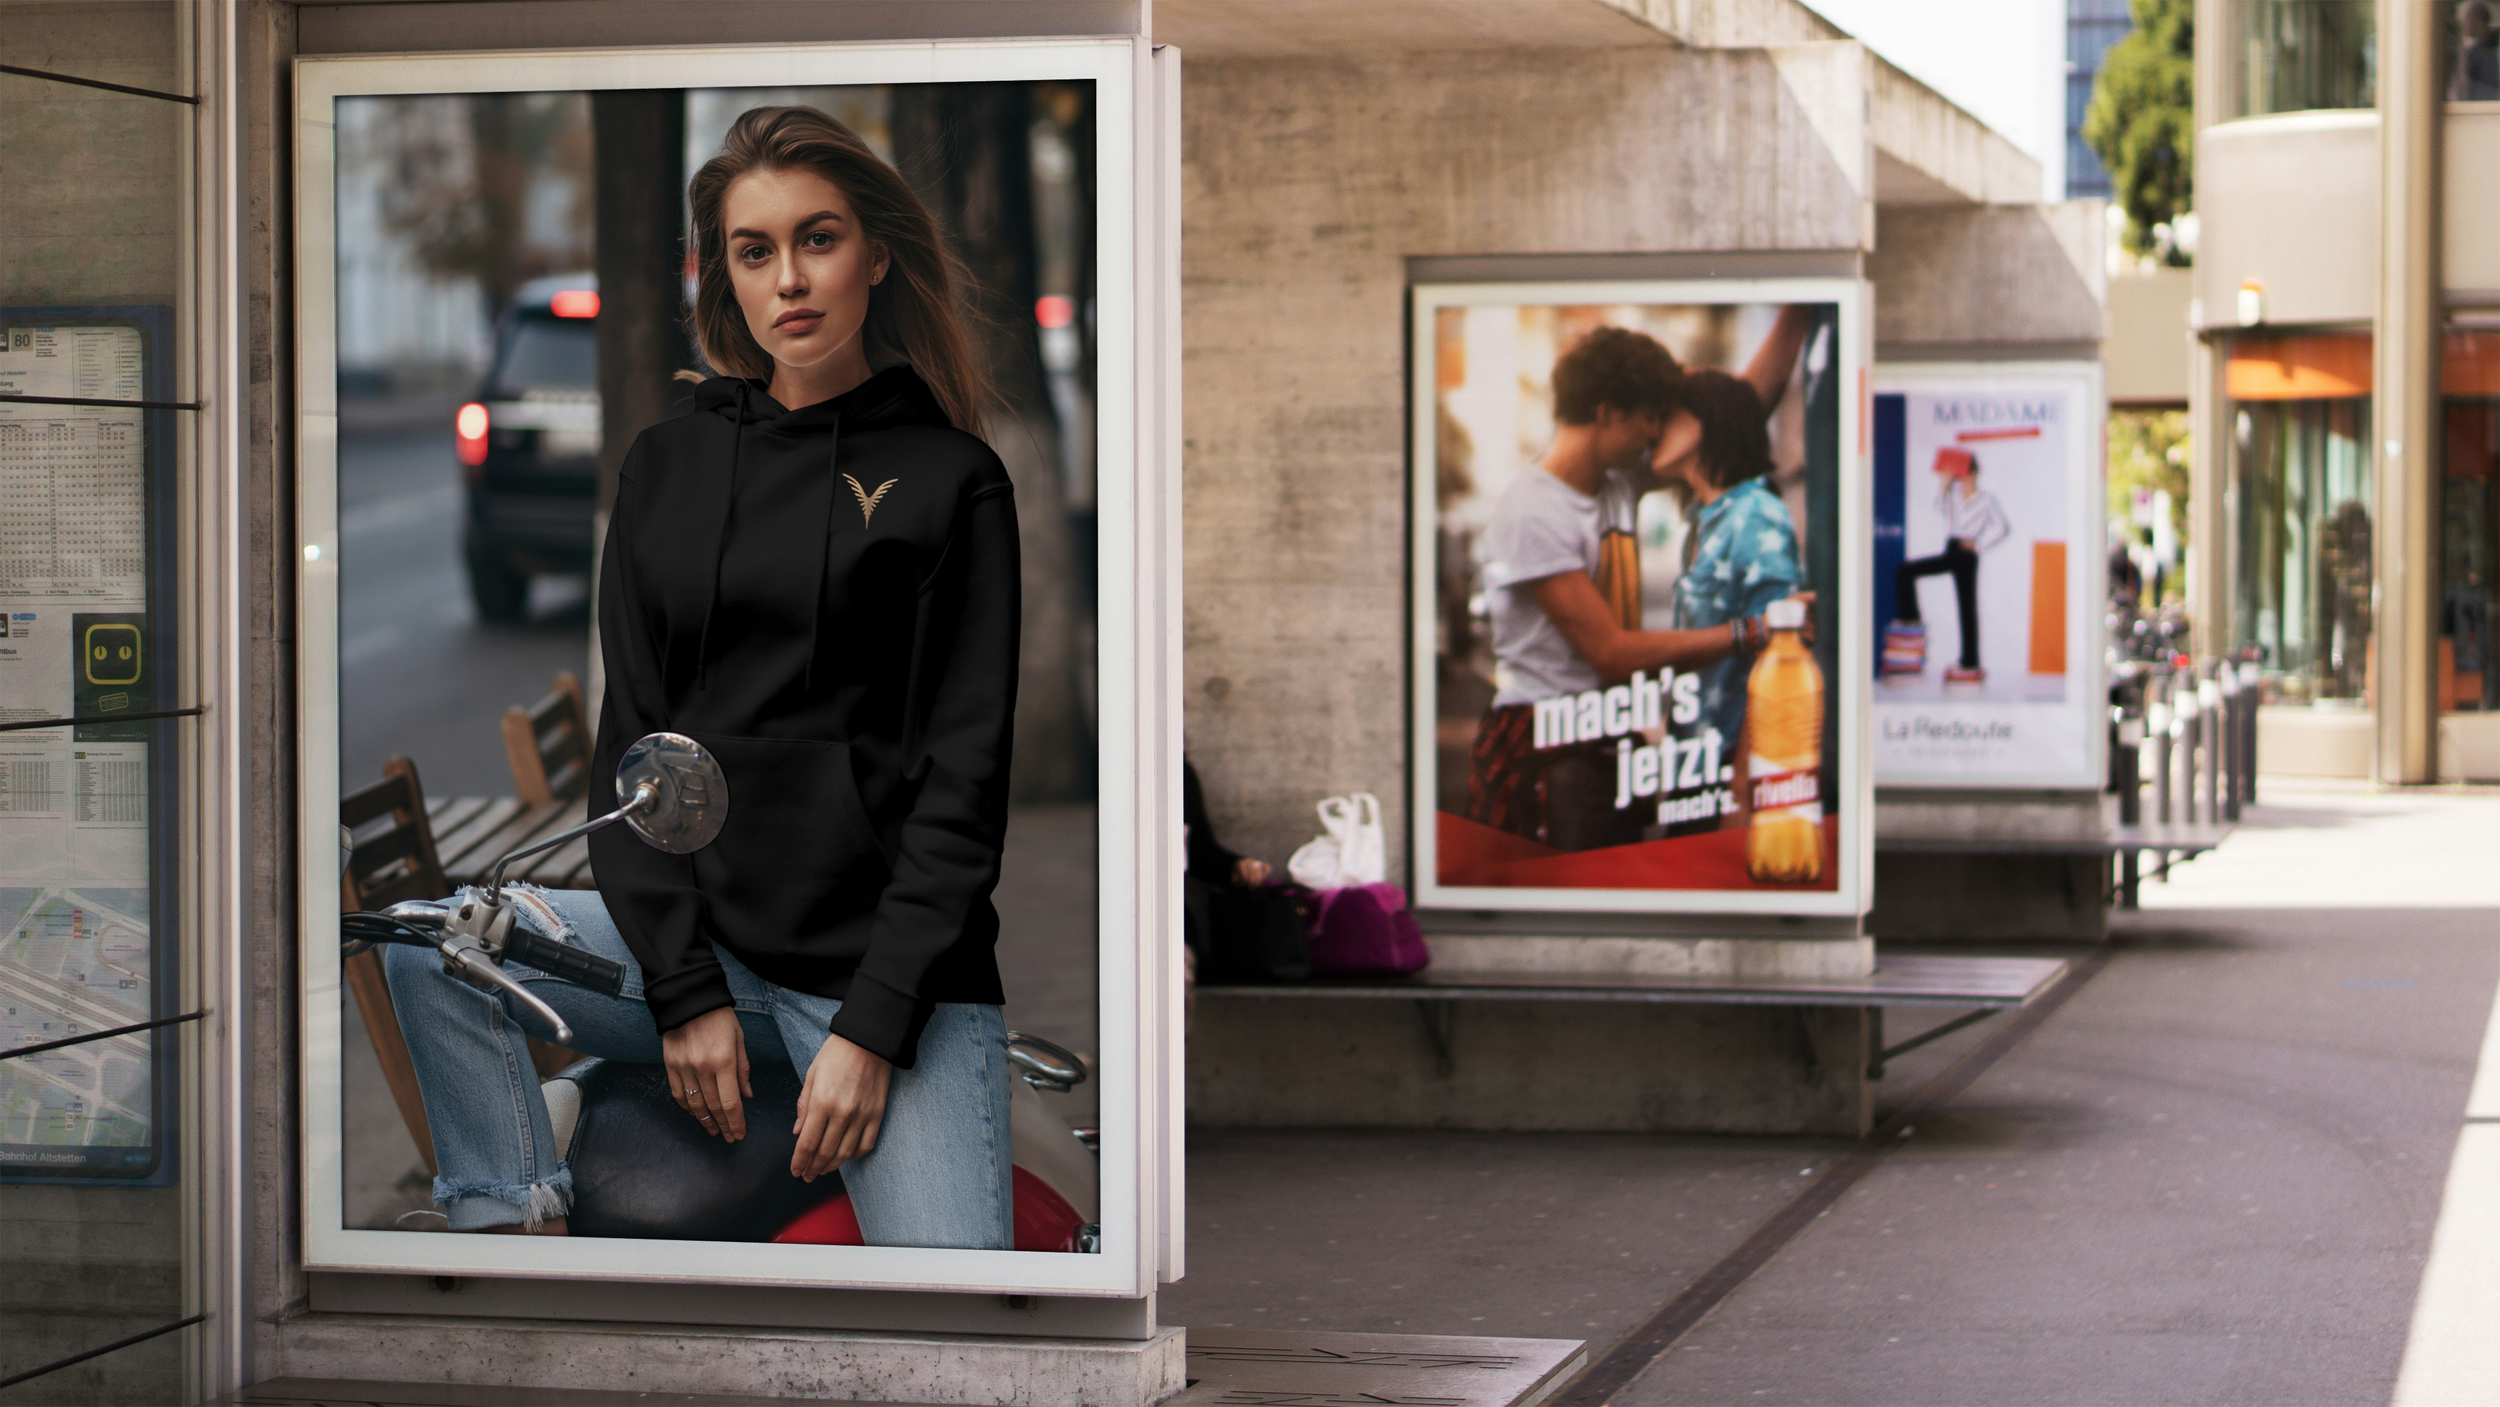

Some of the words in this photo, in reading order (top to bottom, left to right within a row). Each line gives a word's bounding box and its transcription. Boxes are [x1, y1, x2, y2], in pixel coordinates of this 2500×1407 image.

[14, 334, 31, 347] 80
[1932, 400, 2060, 425] MADAME
[1533, 665, 1700, 749] mach's
[1883, 716, 1909, 740] La
[1913, 715, 2012, 740] Redoute
[1615, 727, 1735, 808] jetzt.
[1658, 788, 1740, 825] mach's.
[1754, 772, 1818, 810] rivella
[0, 1151, 37, 1162] Bahnhof
[40, 1152, 87, 1163] Altstetten
